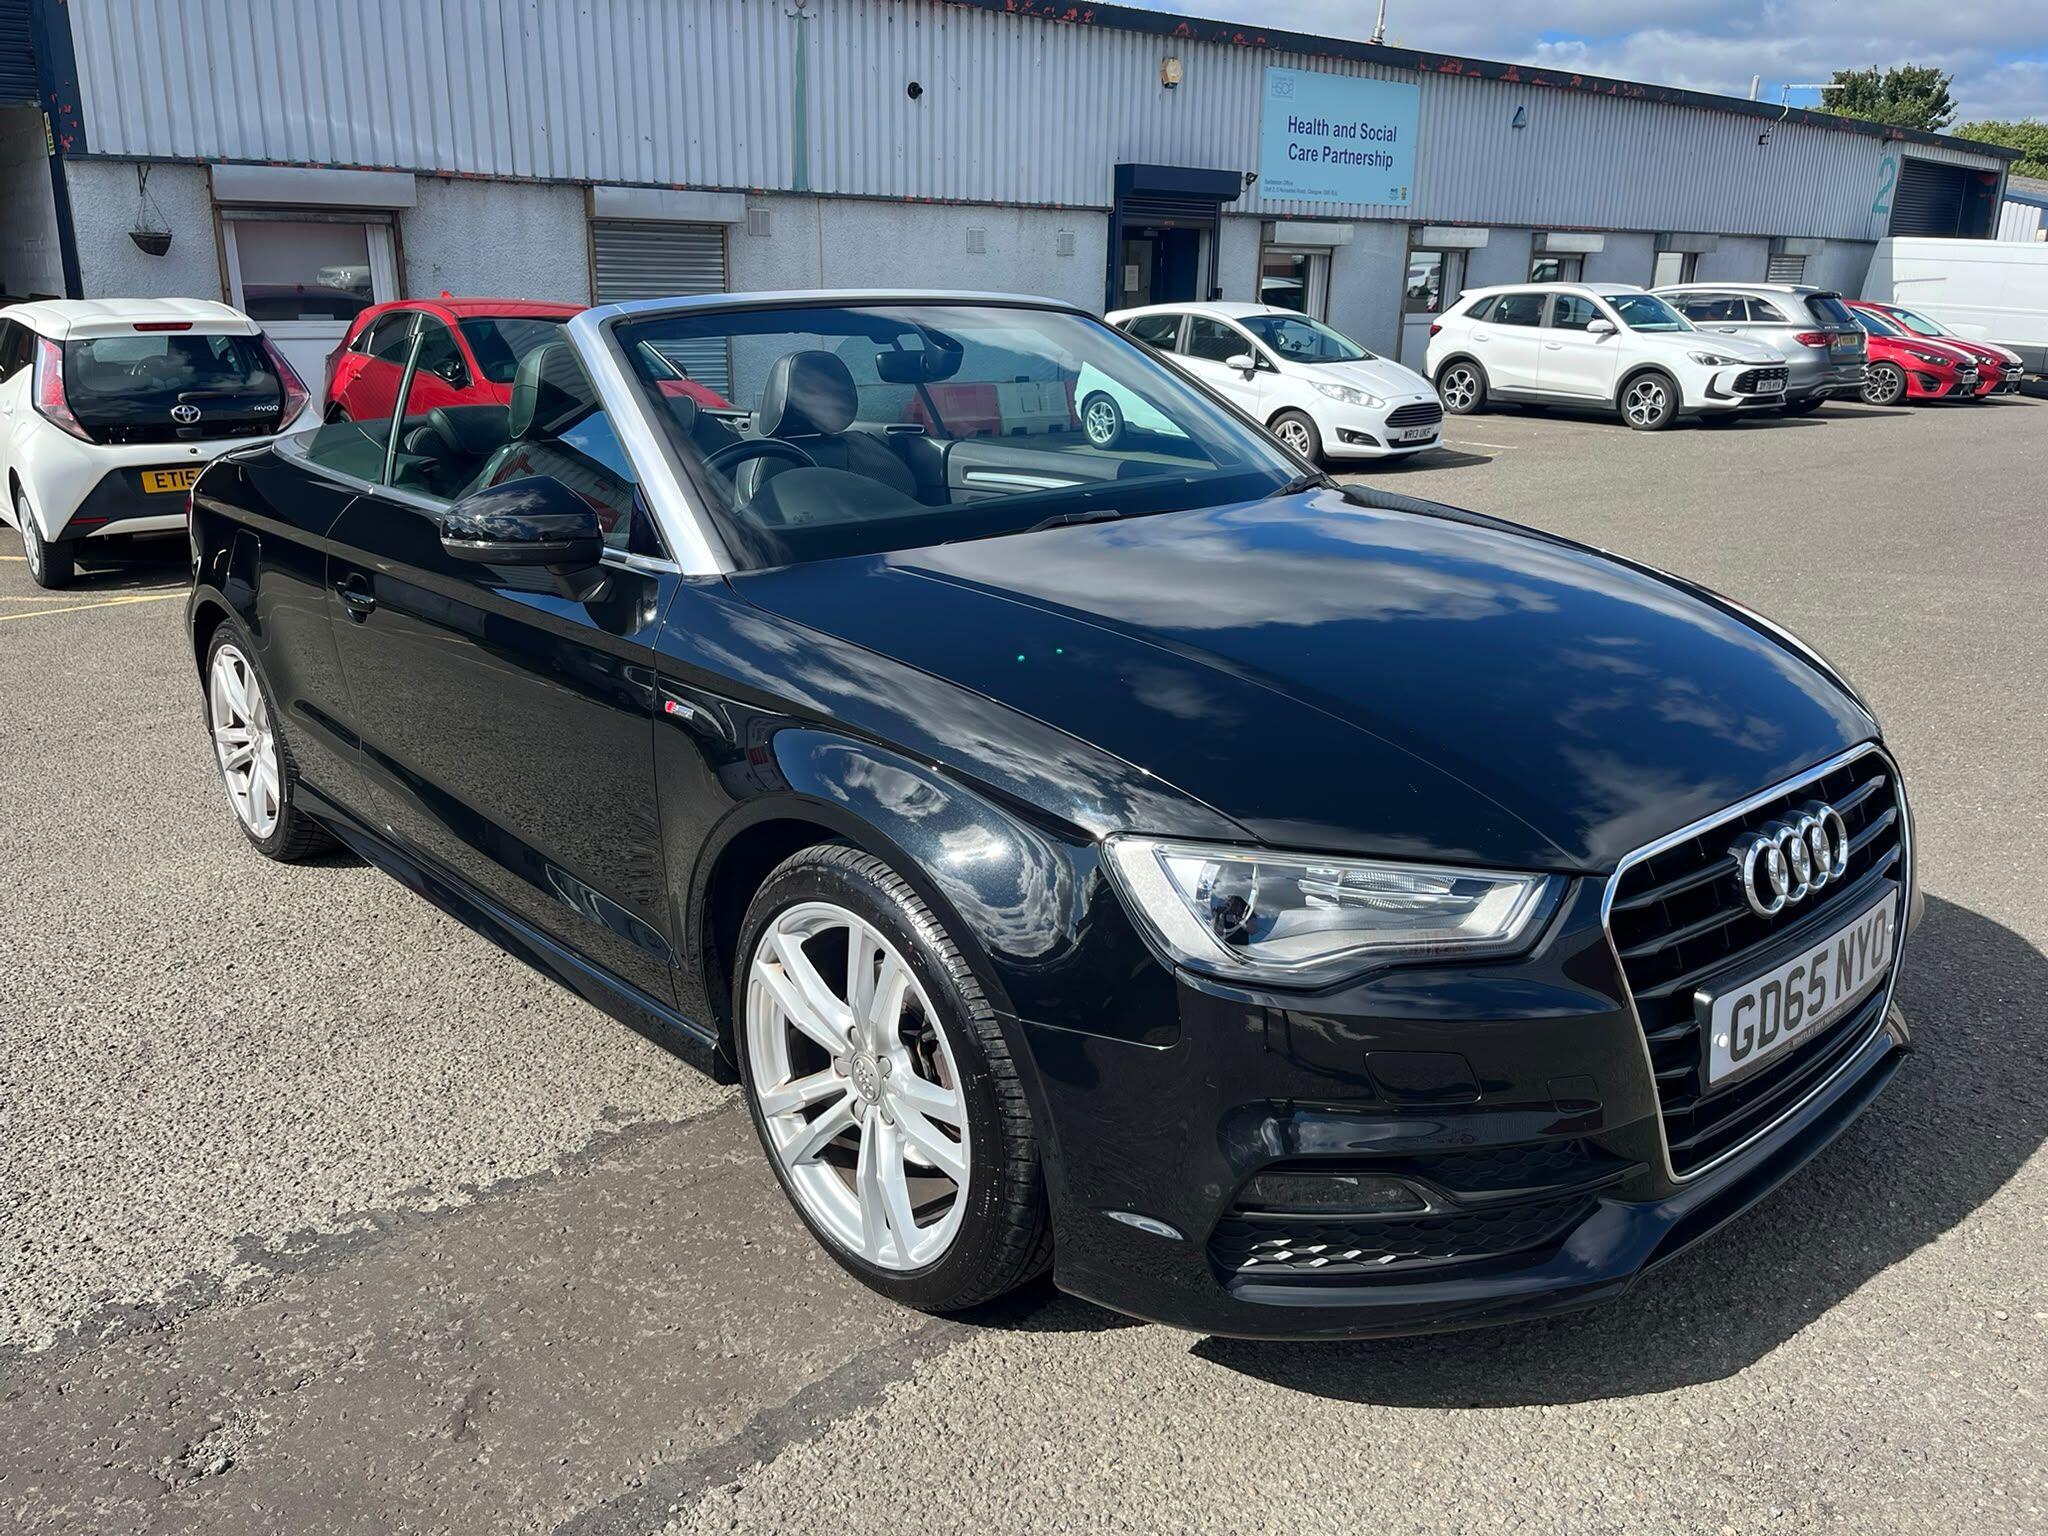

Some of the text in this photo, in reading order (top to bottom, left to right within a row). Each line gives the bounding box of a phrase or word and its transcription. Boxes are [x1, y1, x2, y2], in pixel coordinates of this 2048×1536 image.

[1287, 115, 1397, 143] Health and Social
[1288, 143, 1394, 171] Care Partnership
[1872, 156, 1896, 213] 2
[154, 471, 195, 488] ET15
[1729, 907, 1887, 1062] GD65 NYO
